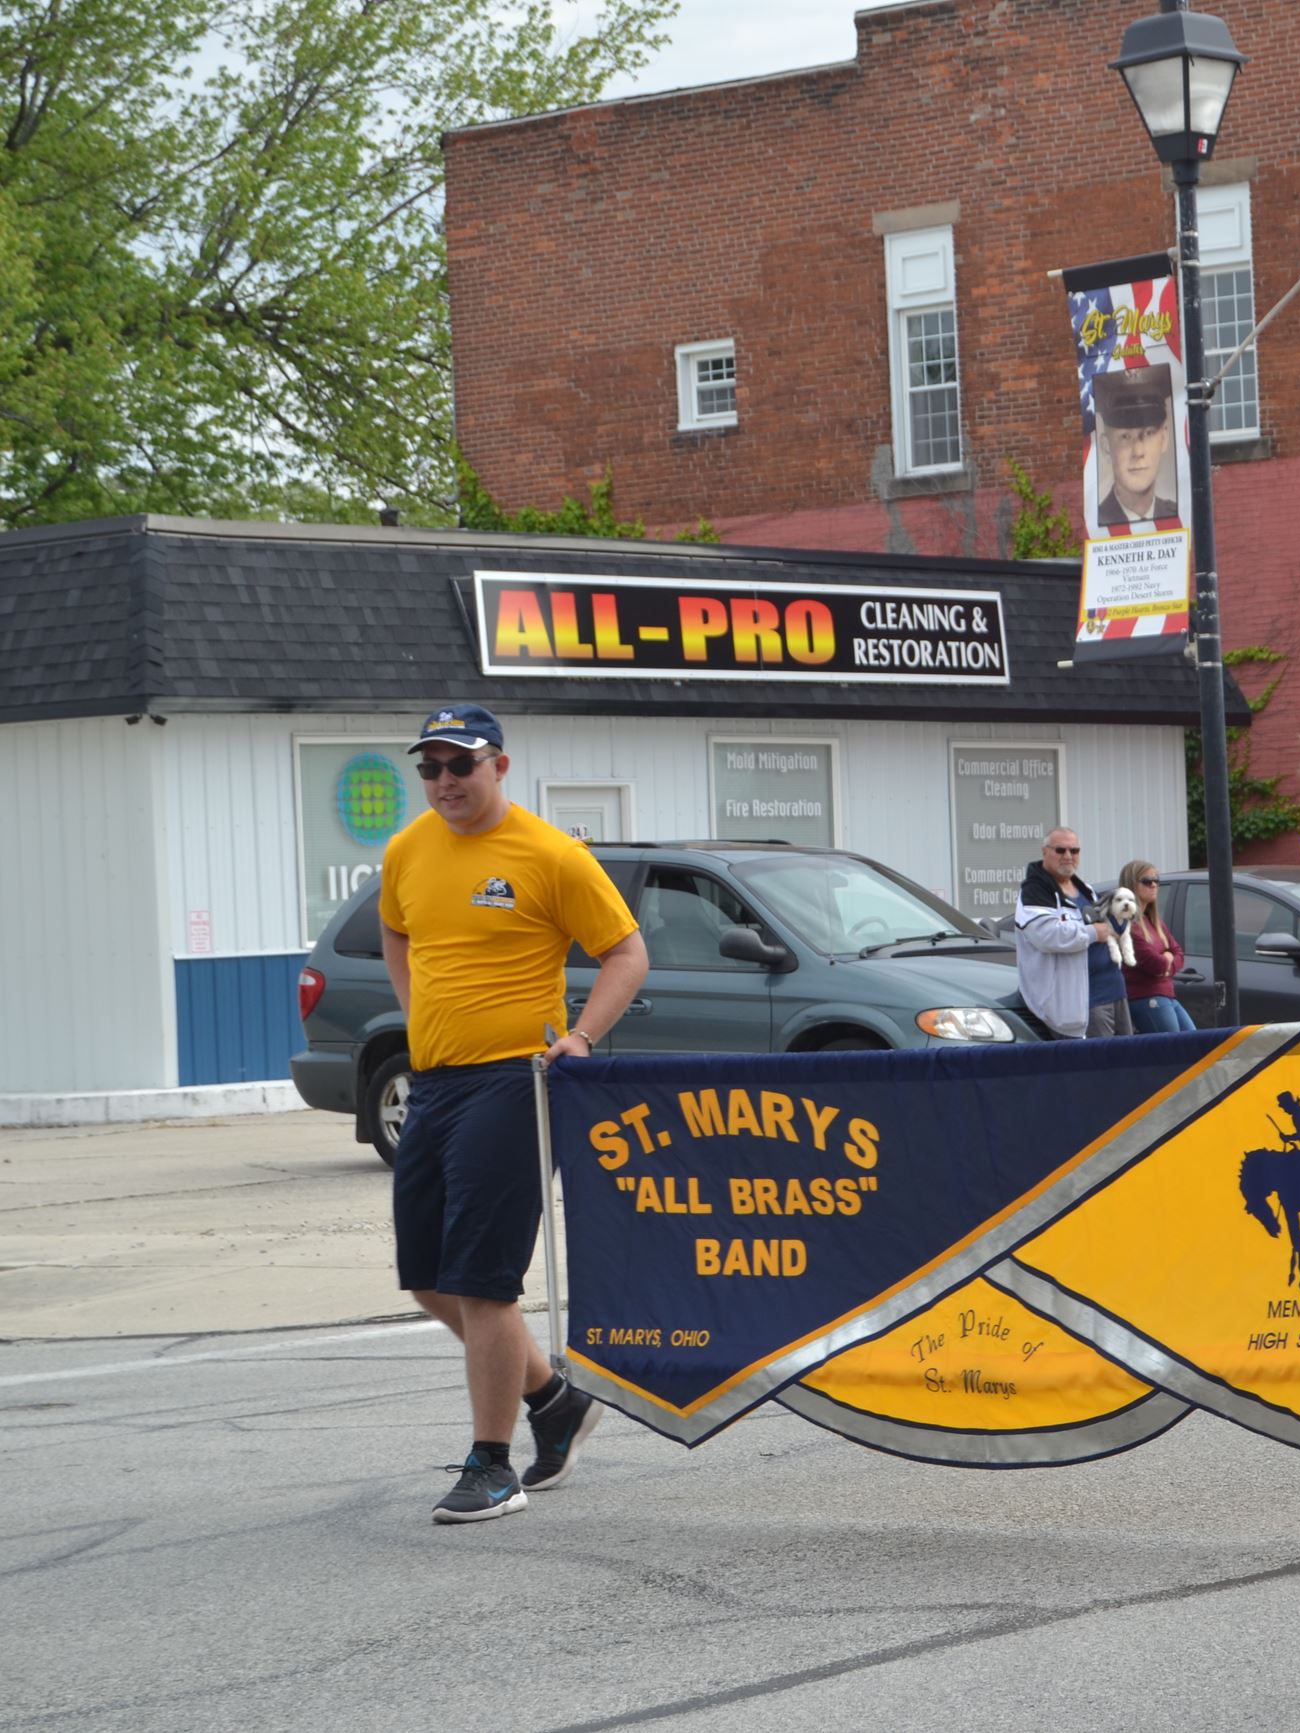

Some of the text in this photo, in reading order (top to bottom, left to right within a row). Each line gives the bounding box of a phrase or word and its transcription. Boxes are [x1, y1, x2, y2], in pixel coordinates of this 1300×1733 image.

[1082, 304, 1172, 346] St. Marys
[1097, 547, 1177, 567] KENNETH R. DAY
[860, 601, 988, 634] CLEANING &
[853, 638, 1000, 669] RESTORATION
[726, 751, 818, 773] Mold Mitigation
[958, 758, 1054, 779] Commercial Office
[984, 779, 1030, 800] Cleaning
[726, 799, 822, 817] Fire Restoration
[972, 822, 1044, 839] Odor Removal
[964, 866, 1026, 884] Commercial
[974, 888, 1000, 905] Floor
[588, 1088, 880, 1171] ST. MARYS
[616, 1176, 878, 1216] "ALL BRASS"
[695, 1238, 807, 1277] BAND
[586, 1328, 711, 1348] ST. MARYS, OHIO
[911, 1333, 945, 1364] The
[959, 1309, 1011, 1342] Pride
[1248, 1332, 1289, 1351] HIGH
[924, 1367, 1017, 1401] St. Marys
